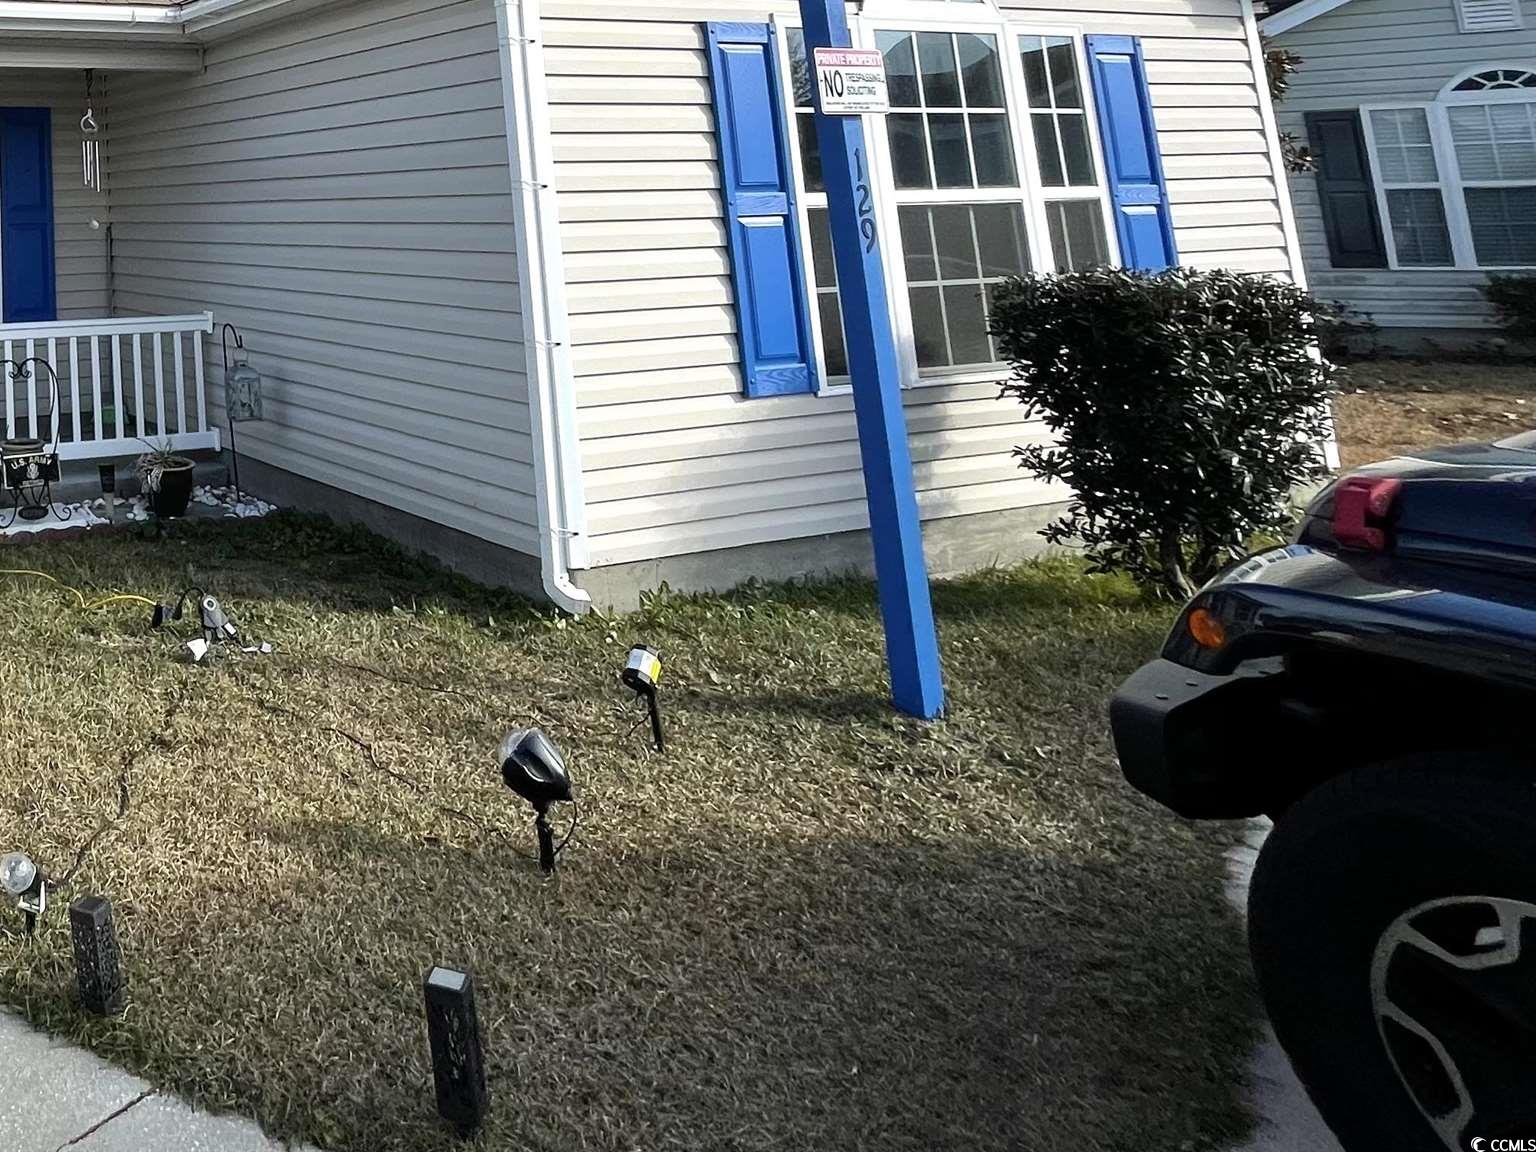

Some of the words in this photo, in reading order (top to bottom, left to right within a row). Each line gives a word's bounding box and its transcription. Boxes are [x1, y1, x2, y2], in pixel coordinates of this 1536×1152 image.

[823, 70, 844, 97] NO
[854, 147, 877, 254] 129
[10, 458, 28, 470] U.S.
[28, 455, 52, 465] ARMY
